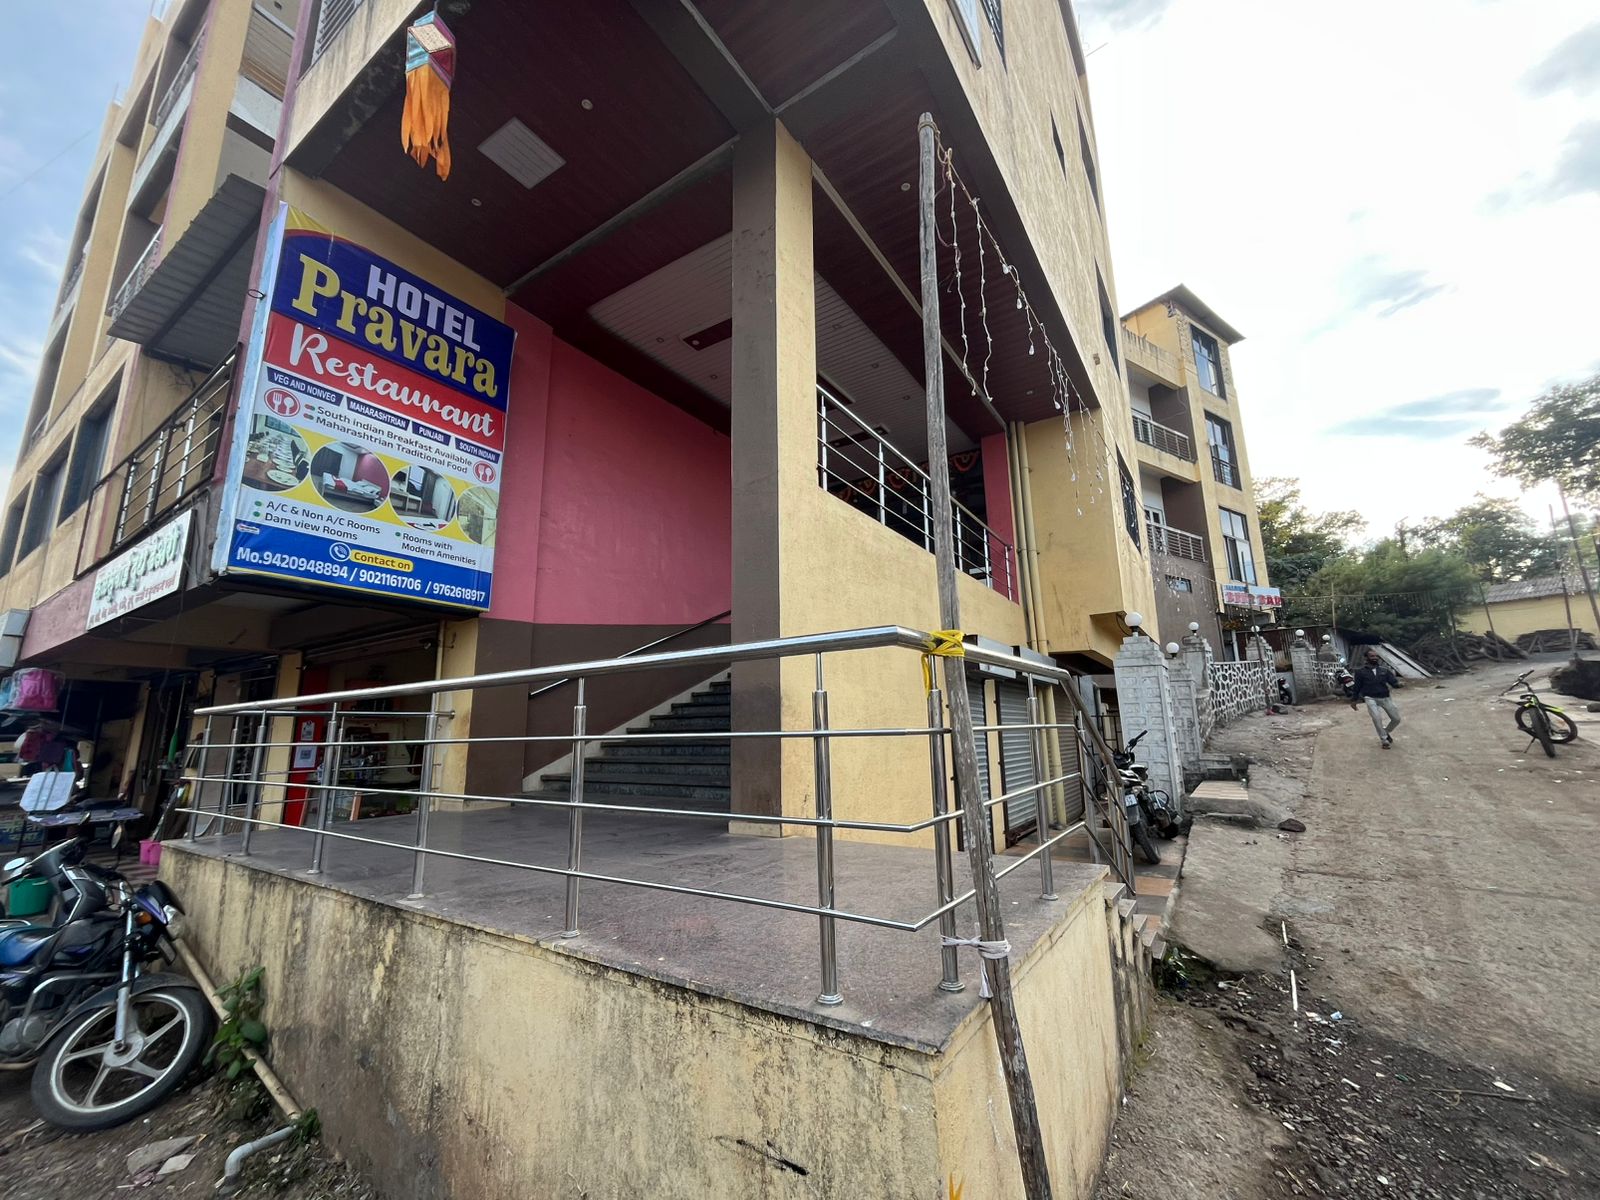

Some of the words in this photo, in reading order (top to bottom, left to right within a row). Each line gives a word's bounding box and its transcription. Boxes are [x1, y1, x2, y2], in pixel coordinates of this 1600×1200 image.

[367, 264, 481, 352] HOTEL
[291, 253, 498, 398] Pravara
[274, 373, 289, 386] VEG
[290, 379, 306, 391] AND
[307, 385, 337, 403] NONVEG
[289, 323, 495, 437] Restaurant
[349, 401, 407, 428] MAHARASHTRIAN
[316, 416, 394, 449] Maharashtrian
[396, 444, 445, 466] Traditional
[447, 462, 468, 474] Food
[317, 406, 351, 422] South
[353, 418, 385, 436] indian
[387, 431, 433, 453] Breakfast
[435, 448, 473, 467] Available
[419, 426, 445, 443] PUNJABI
[460, 442, 478, 455] SOUTH
[478, 449, 496, 461] INDIAN
[265, 512, 292, 526] Dam
[294, 519, 321, 532] view
[322, 525, 359, 541] Rooms
[266, 500, 289, 512] A/C
[290, 506, 299, 515] &
[302, 508, 324, 521] Non
[326, 515, 346, 526] A/C
[347, 519, 381, 534] Rooms
[401, 542, 435, 557] Modern
[436, 550, 477, 566] Amenities
[402, 533, 433, 546] Rooms
[434, 540, 453, 551] with
[354, 551, 396, 567] Contact
[397, 562, 410, 571] on
[359, 569, 422, 591] 9021161706
[432, 583, 486, 602] 9762618917
